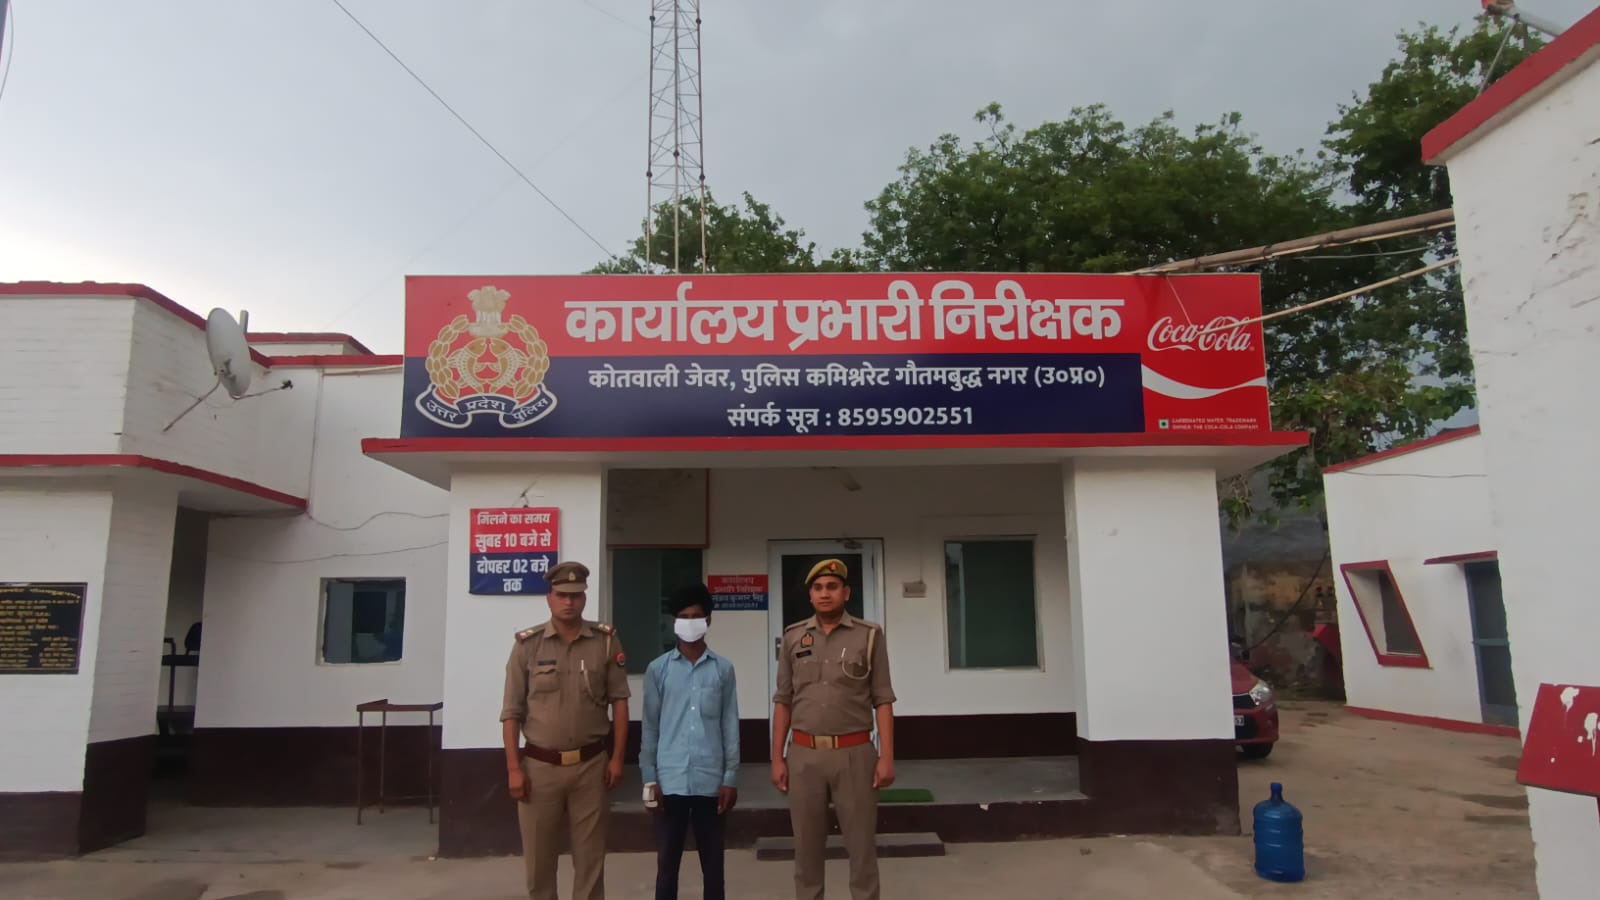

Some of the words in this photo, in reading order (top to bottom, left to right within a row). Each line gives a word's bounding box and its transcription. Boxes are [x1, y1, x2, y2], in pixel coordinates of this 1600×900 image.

[564, 281, 778, 344] कार्यालय
[783, 280, 924, 351] प्रभारी
[928, 280, 1125, 341] निरीक्षक
[1147, 316, 1251, 351] Coca-Cola
[588, 363, 679, 388] कोतवाली
[684, 362, 736, 391] जेवर,
[741, 363, 800, 393] पुलिस
[895, 360, 982, 391] गौतमबुद्ध
[986, 366, 1028, 385] नगर
[426, 400, 458, 421] उत्तर
[465, 396, 506, 411] प्रदेश
[512, 398, 549, 424] पुलिस
[727, 402, 781, 426] संपर्क
[786, 408, 819, 433] सूत्र
[838, 406, 974, 427] 8595902551
[477, 512, 507, 525] मिलने
[509, 513, 522, 524] का
[524, 513, 551, 524] समय
[475, 533, 502, 552] सुबह
[504, 533, 517, 547] 10
[519, 529, 538, 547] बजे
[539, 529, 552, 547] से
[476, 556, 511, 574] दोपहर
[513, 558, 528, 573] 02
[530, 554, 549, 573] बजे
[503, 578, 523, 592] तक
